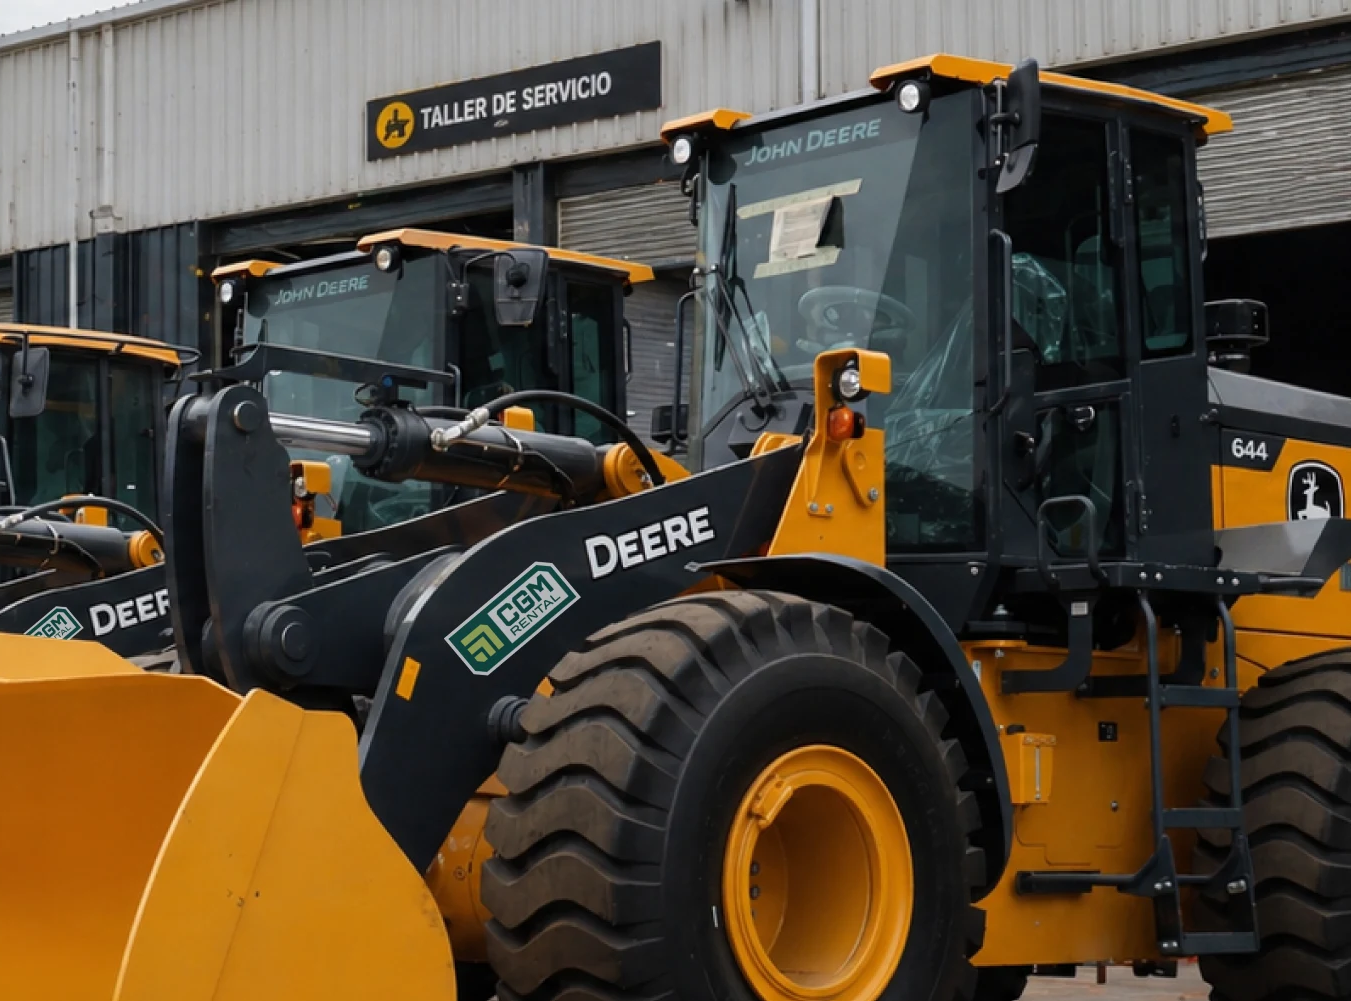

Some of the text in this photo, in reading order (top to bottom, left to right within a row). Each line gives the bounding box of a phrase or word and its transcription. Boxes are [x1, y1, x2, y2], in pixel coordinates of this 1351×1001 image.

[420, 71, 612, 130] TALLER DE SERVICIO
[744, 118, 882, 166] JOHN DEERE
[274, 274, 371, 306] JOHN DEERE
[1231, 437, 1269, 461] 644
[584, 506, 716, 580] DEERE
[89, 588, 171, 637] DEER
[497, 573, 555, 627] CGM
[510, 595, 561, 636] RENTAL
